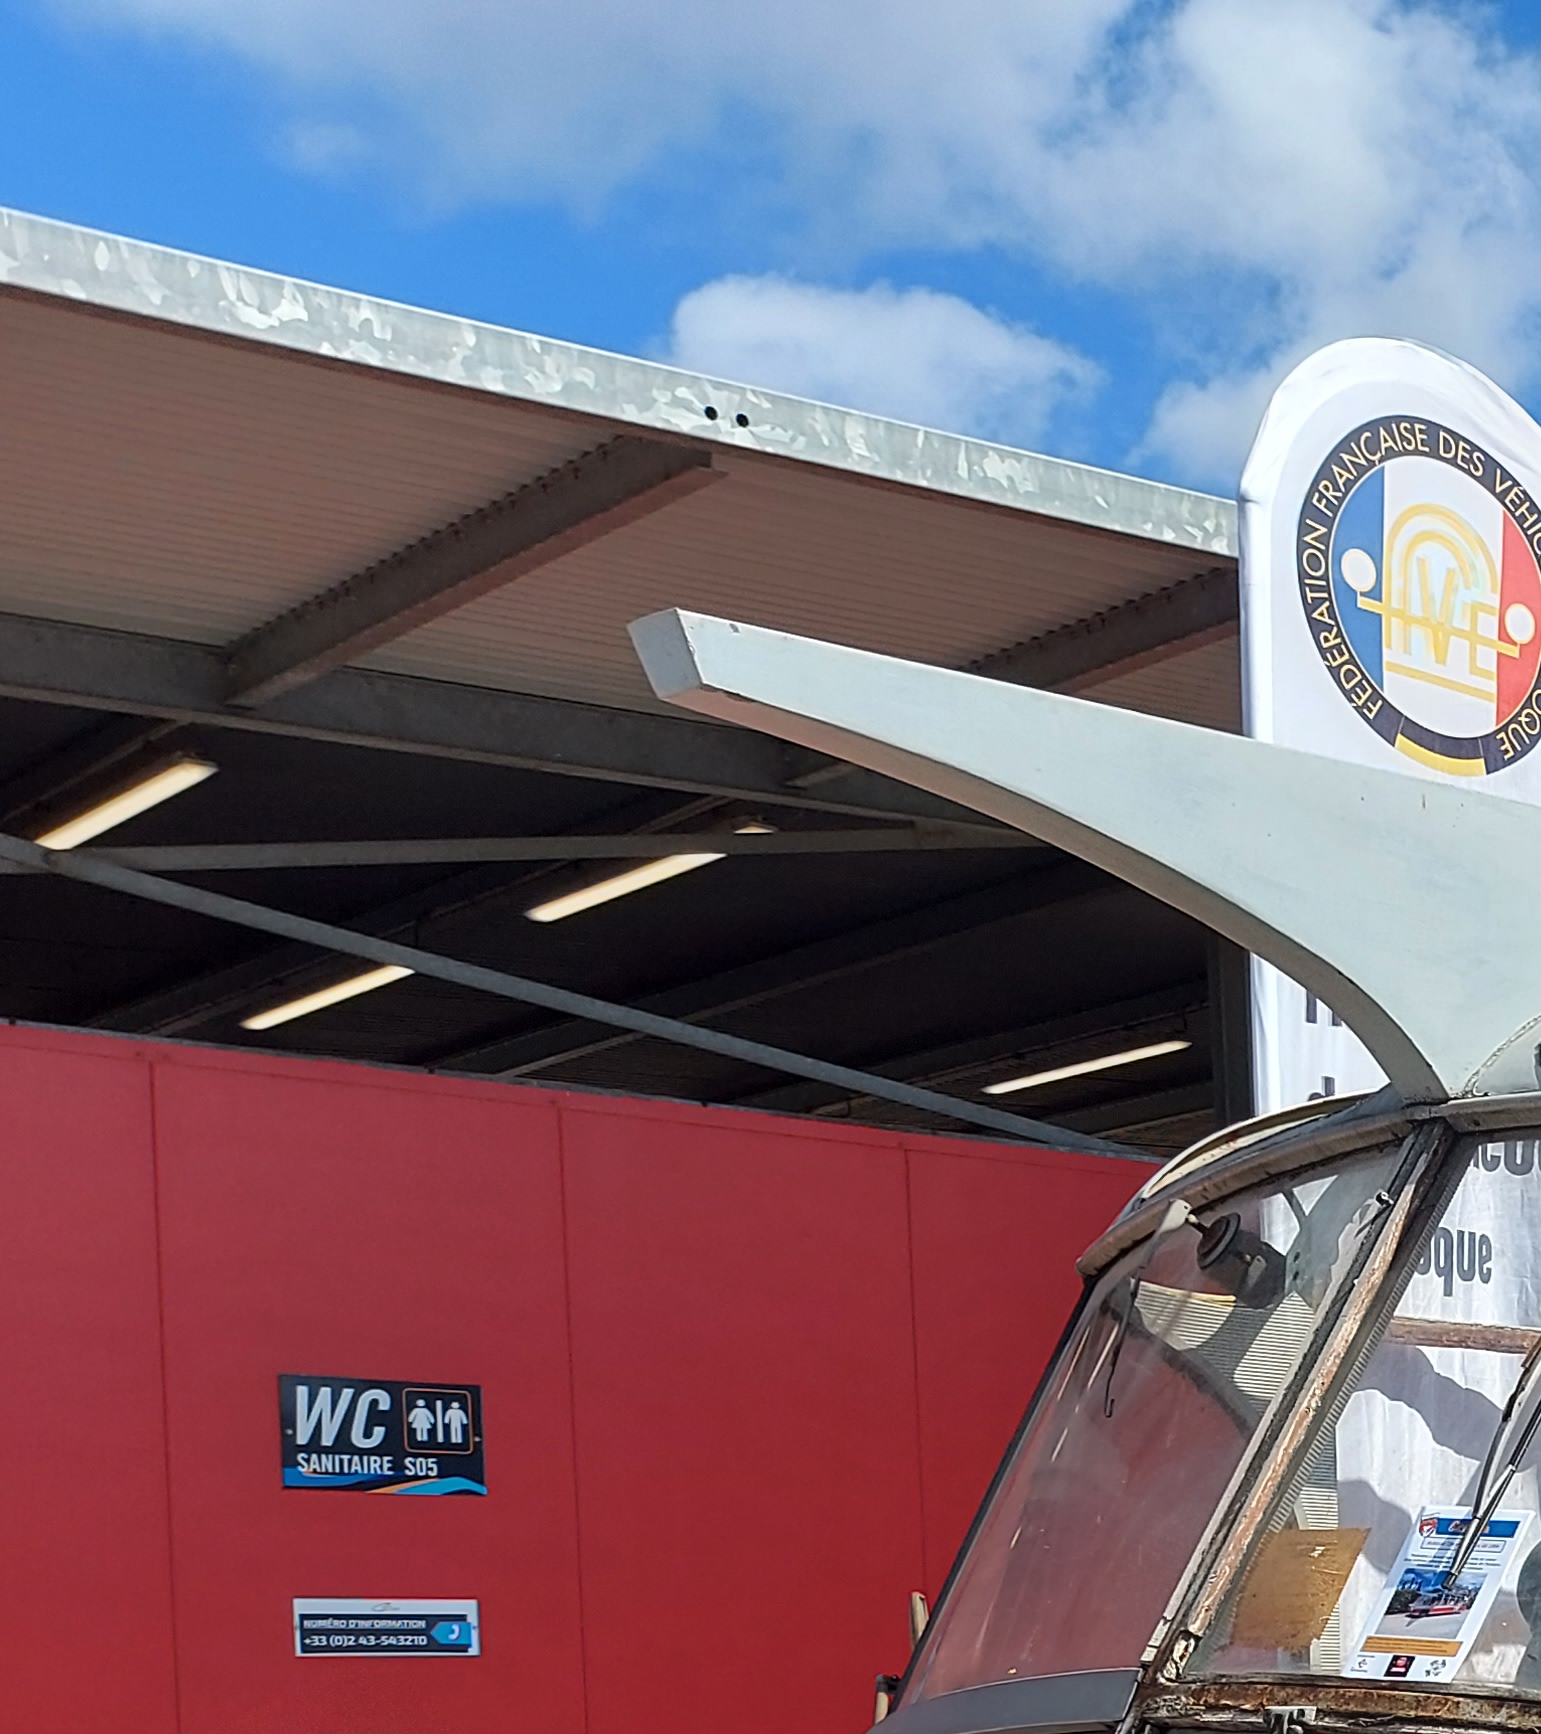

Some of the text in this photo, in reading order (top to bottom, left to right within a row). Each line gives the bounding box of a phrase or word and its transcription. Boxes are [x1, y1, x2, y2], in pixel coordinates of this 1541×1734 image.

[1313, 422, 1431, 518] FRANÇAISE
[1439, 430, 1485, 477] DES
[1303, 520, 1384, 720] FÉDÉRATION
[296, 1384, 391, 1449] WC
[296, 1452, 438, 1477] SANITAIRE S05
[303, 1617, 426, 1630] NUMÉRO D'INFORMATION
[303, 1634, 428, 1648] +33 (0)2 43-543210
